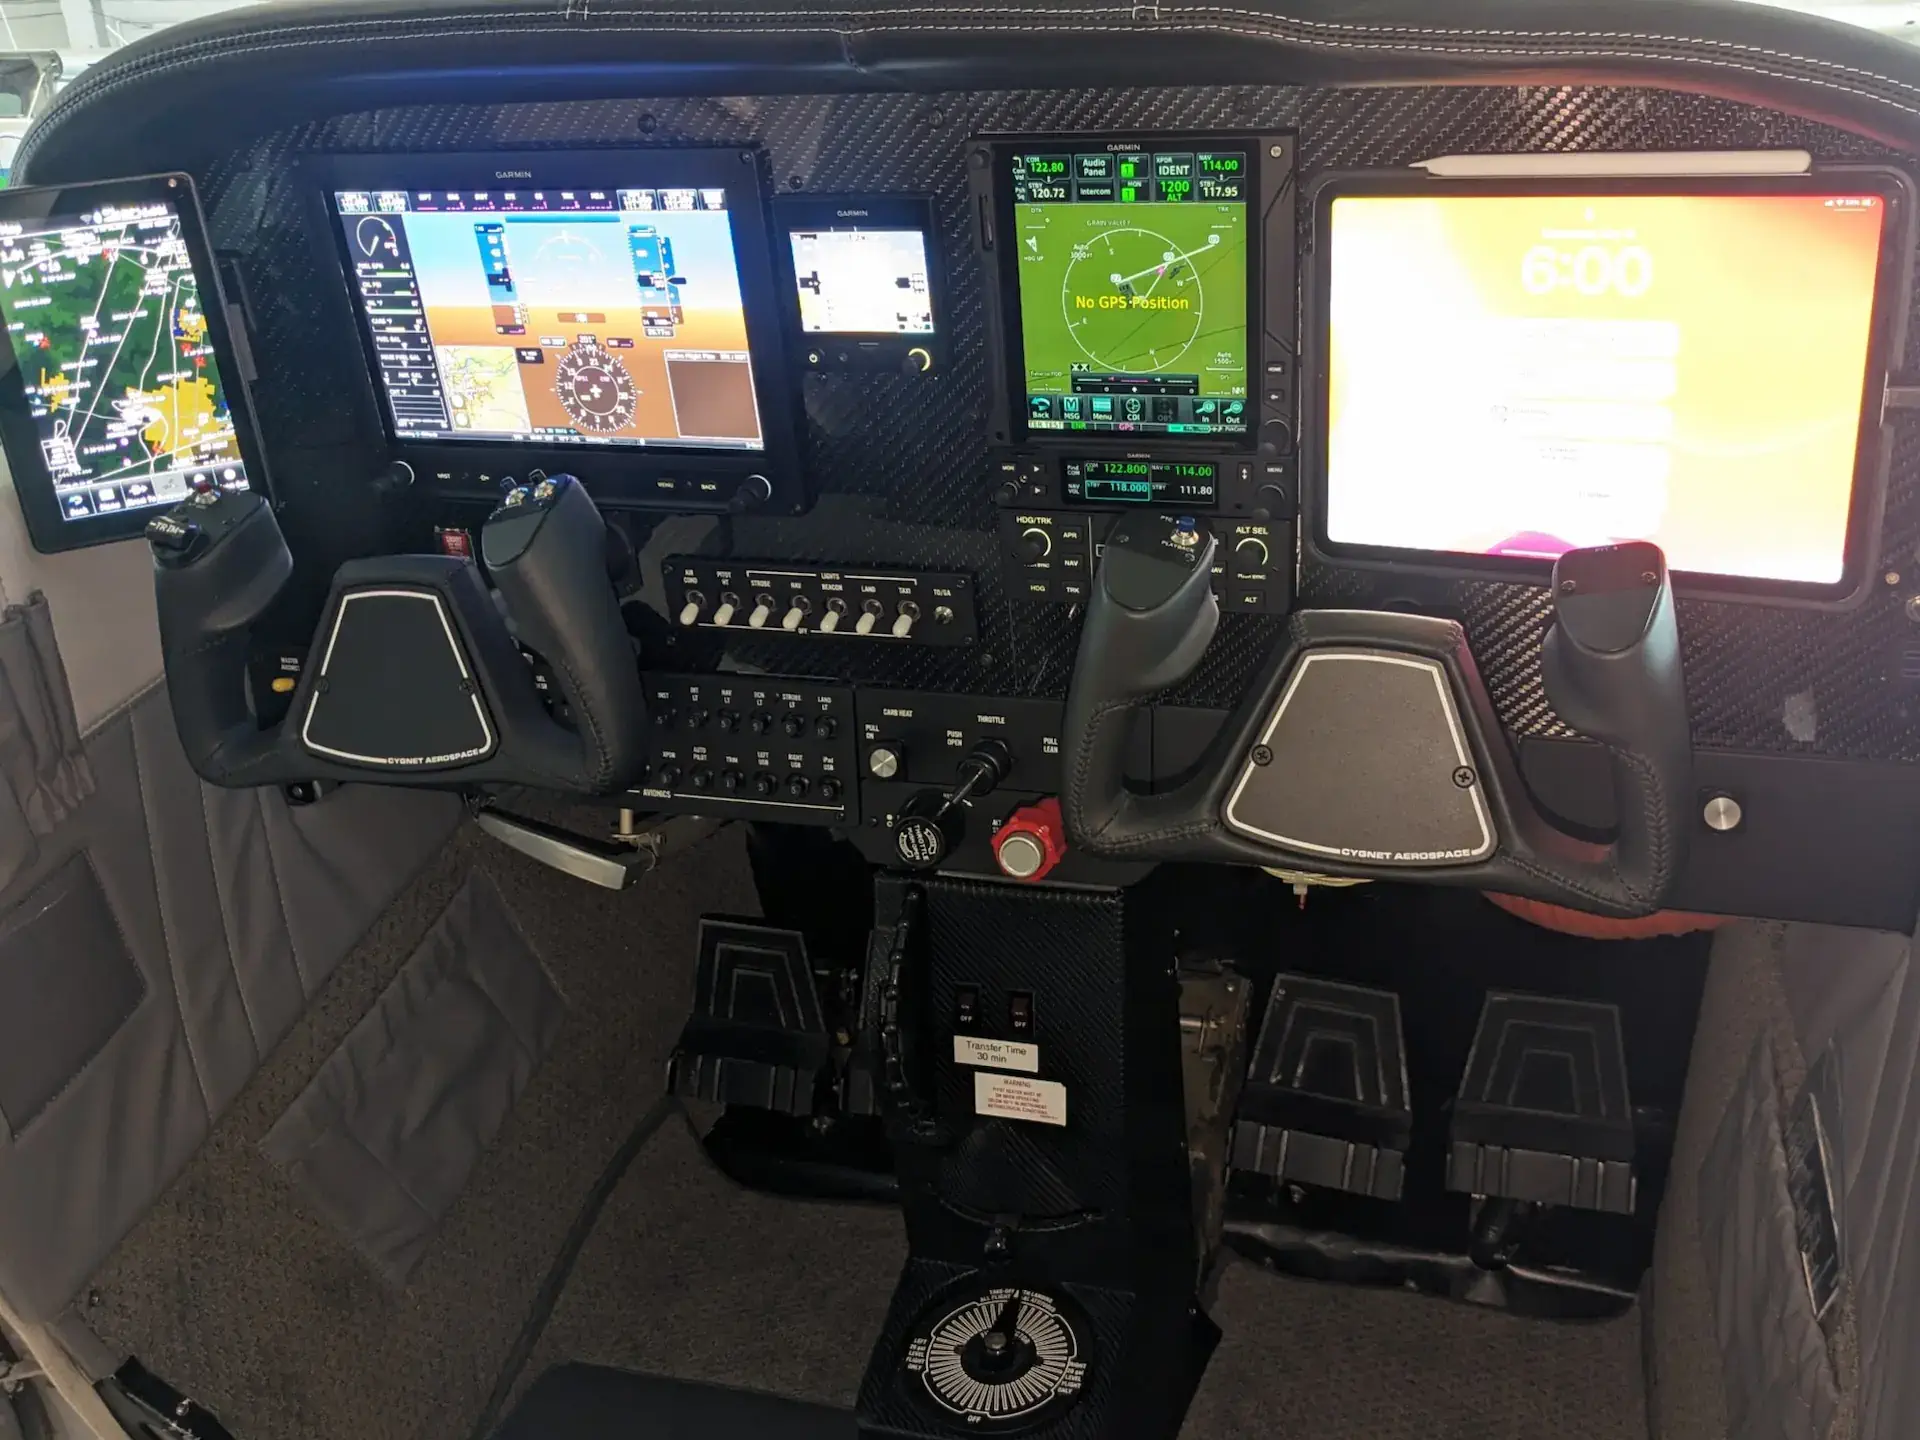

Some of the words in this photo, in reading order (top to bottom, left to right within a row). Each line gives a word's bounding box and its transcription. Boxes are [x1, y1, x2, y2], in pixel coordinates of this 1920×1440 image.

[1107, 144, 1141, 152] GARMIN
[1031, 162, 1064, 173] 122.80
[1082, 159, 1106, 168] Audio
[1203, 161, 1238, 171] 114.00
[495, 170, 532, 180] GARMIN
[1083, 168, 1106, 177] Panel
[1158, 165, 1190, 176] IDENT
[1028, 182, 1043, 190] STBY
[1160, 181, 1190, 192] 1200
[1032, 188, 1065, 199] 120.72
[1080, 188, 1111, 196] Intercom
[1203, 186, 1238, 197] 117.95
[1167, 193, 1182, 202] ALT
[836, 209, 869, 218] GARMIN
[1522, 245, 1652, 296] 6:00
[1076, 296, 1095, 309] No
[1099, 296, 1127, 309] GPS
[1132, 295, 1190, 310] Position
[1032, 411, 1050, 419] Back
[1064, 412, 1080, 420] MSG
[1093, 412, 1112, 421] Menu
[1127, 412, 1140, 421] CDI
[1202, 415, 1210, 423] In
[1119, 423, 1134, 431] GPS
[1104, 463, 1148, 475] 122.800
[1175, 466, 1213, 477] 114.00
[1110, 483, 1148, 493] 118.000
[1180, 485, 1213, 496] 111.80
[1016, 516, 1053, 525] HDG/TRK
[1235, 526, 1251, 534] ALT
[1252, 527, 1269, 535] SEL
[683, 577, 698, 585] COND
[820, 572, 841, 581] LIGHTS
[750, 579, 771, 588] STROBE
[821, 583, 844, 592] BEACON
[861, 585, 876, 594] LAND
[898, 586, 912, 595] TAXI
[817, 696, 833, 704] LAND
[882, 708, 899, 717] CARB
[899, 709, 914, 718] HEAT
[976, 715, 1006, 725] THROTTLE
[864, 724, 880, 733] PULL
[946, 730, 963, 738] PUSH
[946, 738, 963, 747] OPEN
[1043, 737, 1058, 746] PULL
[1043, 745, 1058, 754] LEAN
[387, 756, 424, 765] CYGNET
[425, 748, 480, 765] AEROSPACE
[642, 789, 672, 799] AVIONICS
[1341, 848, 1391, 860] CYGNET
[1394, 849, 1471, 860] AEROSPACE
[966, 1040, 1002, 1052] Transfer
[1005, 1045, 1027, 1056] Time
[977, 1052, 988, 1061] 30
[990, 1053, 1007, 1063] min
[967, 1414, 982, 1423] OFF
